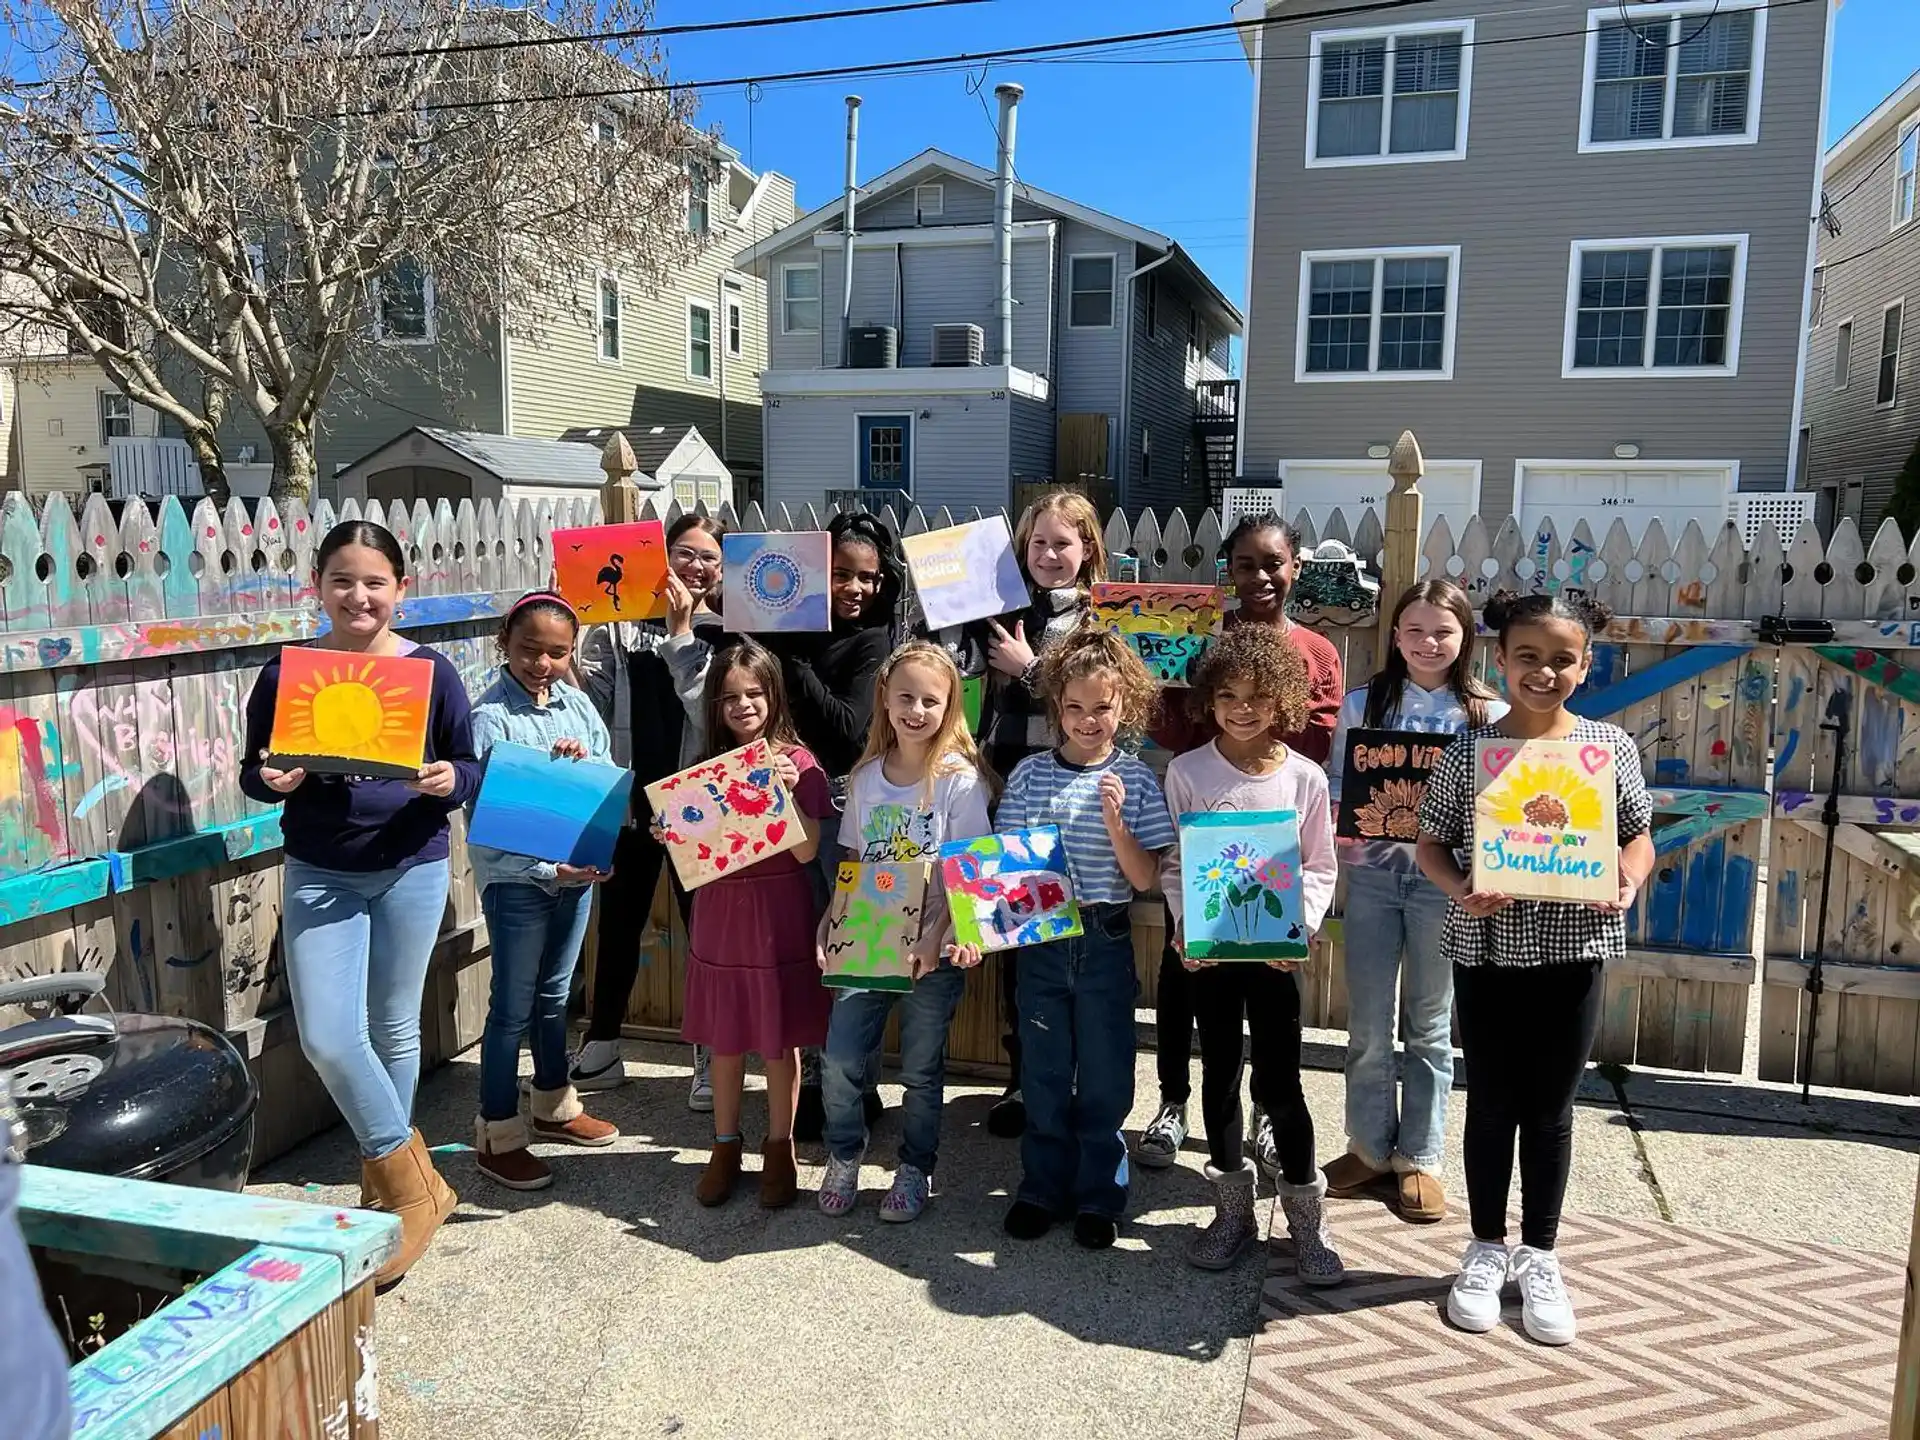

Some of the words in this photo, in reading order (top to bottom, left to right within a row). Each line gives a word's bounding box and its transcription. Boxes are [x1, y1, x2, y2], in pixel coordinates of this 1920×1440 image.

[1601, 497, 1619, 506] 346
[1502, 828, 1530, 842] YOU
[1483, 836, 1605, 879] Sunshine
